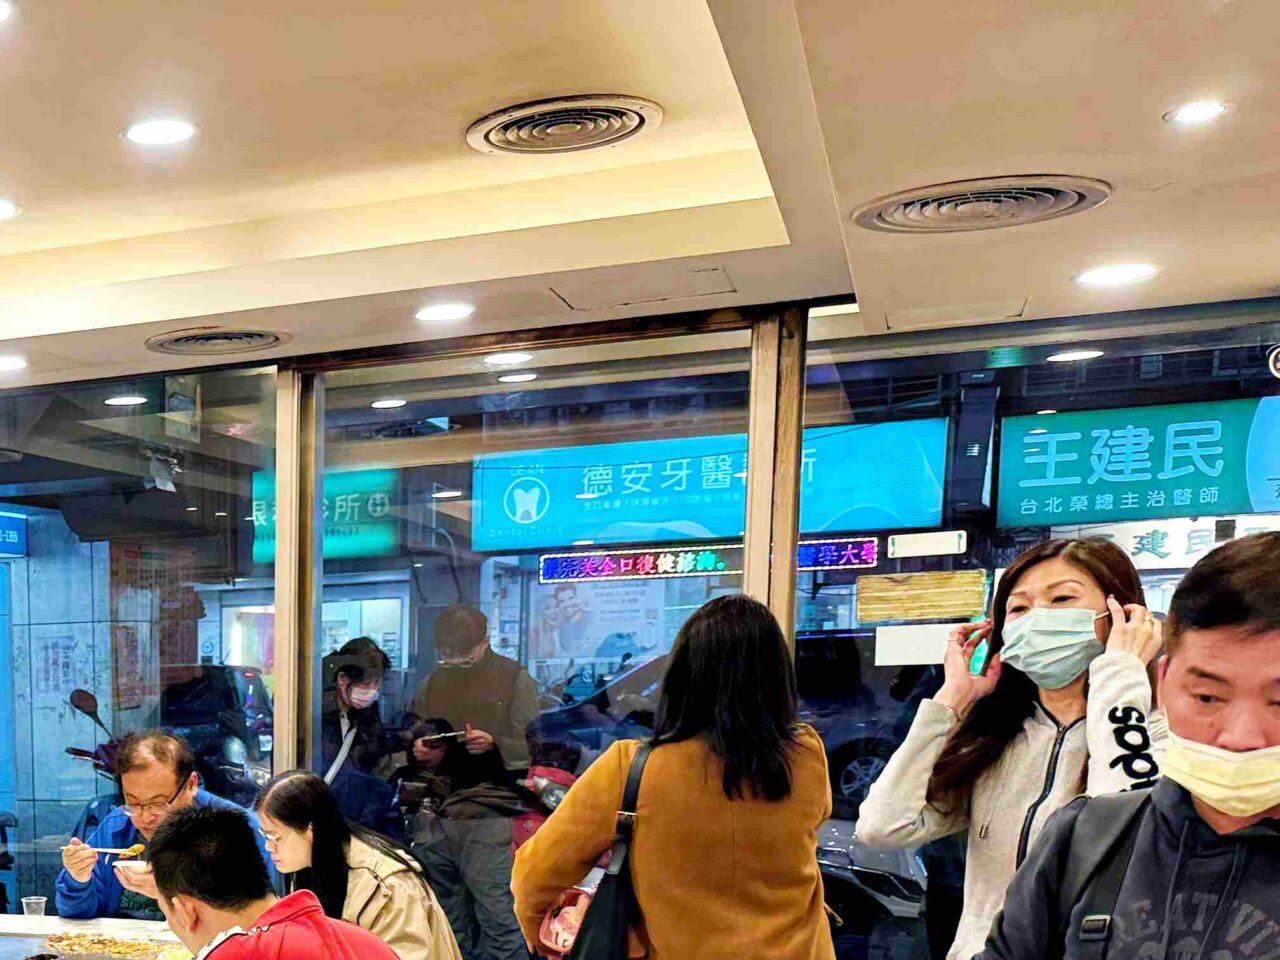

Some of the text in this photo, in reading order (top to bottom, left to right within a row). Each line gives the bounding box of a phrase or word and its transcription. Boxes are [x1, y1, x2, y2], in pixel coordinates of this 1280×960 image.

[1019, 420, 1224, 487] 王建民
[1020, 486, 1219, 515] 台北榮總主治醫師
